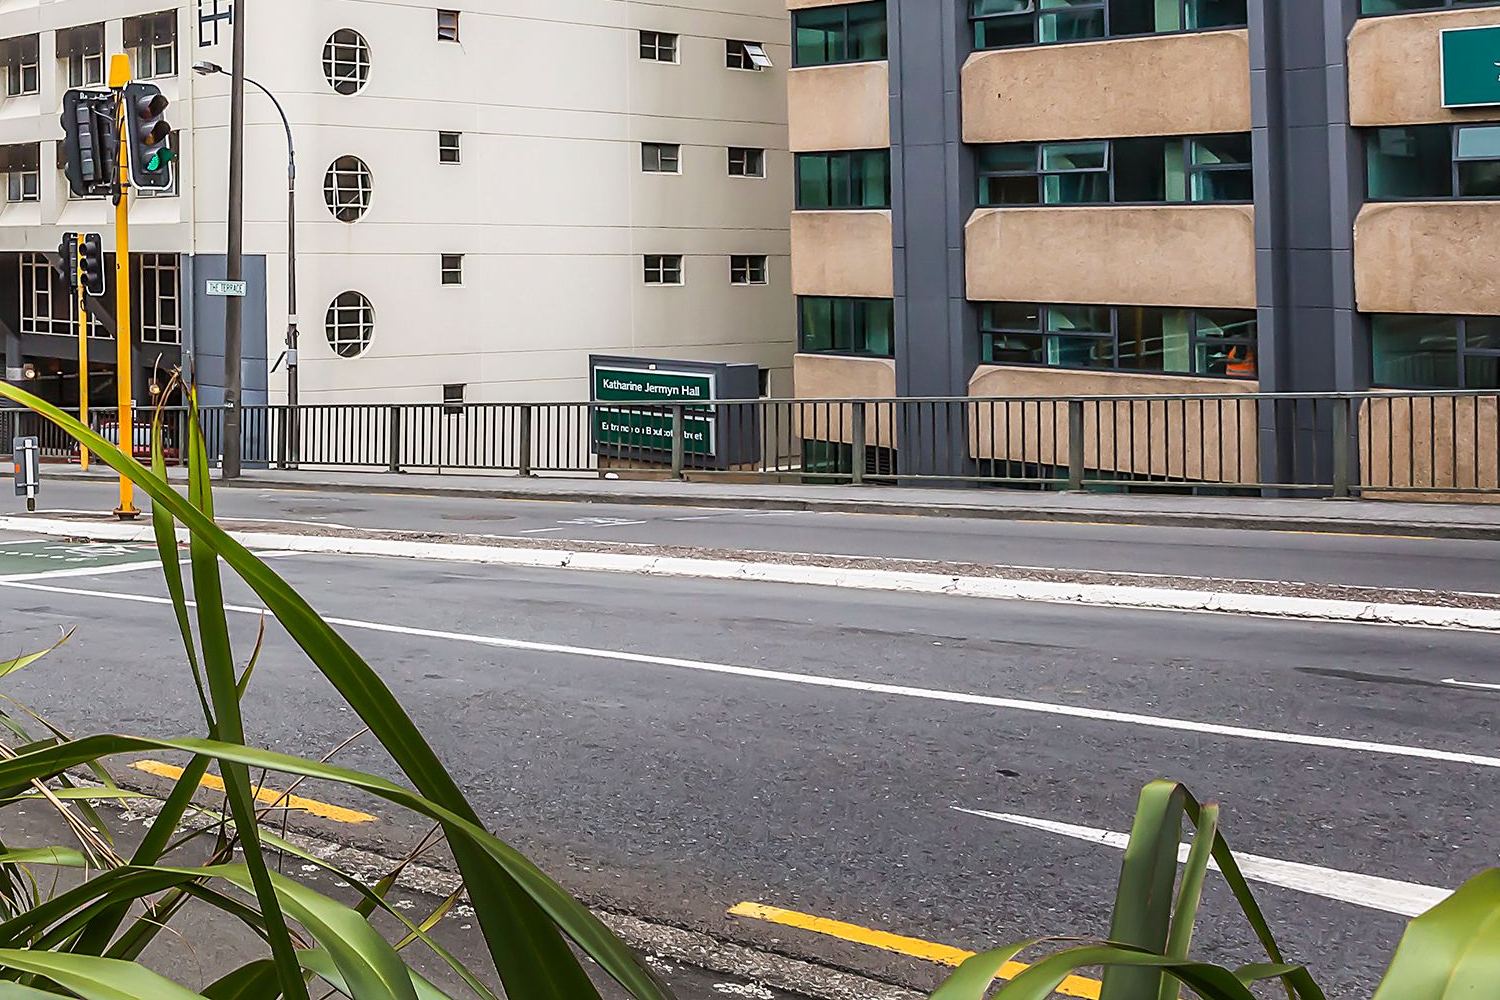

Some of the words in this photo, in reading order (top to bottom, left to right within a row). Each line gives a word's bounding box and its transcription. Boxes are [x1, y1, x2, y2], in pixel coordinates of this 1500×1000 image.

[603, 378, 643, 392] Katharine
[644, 382, 680, 397] Jermyn
[681, 385, 701, 397] Hall
